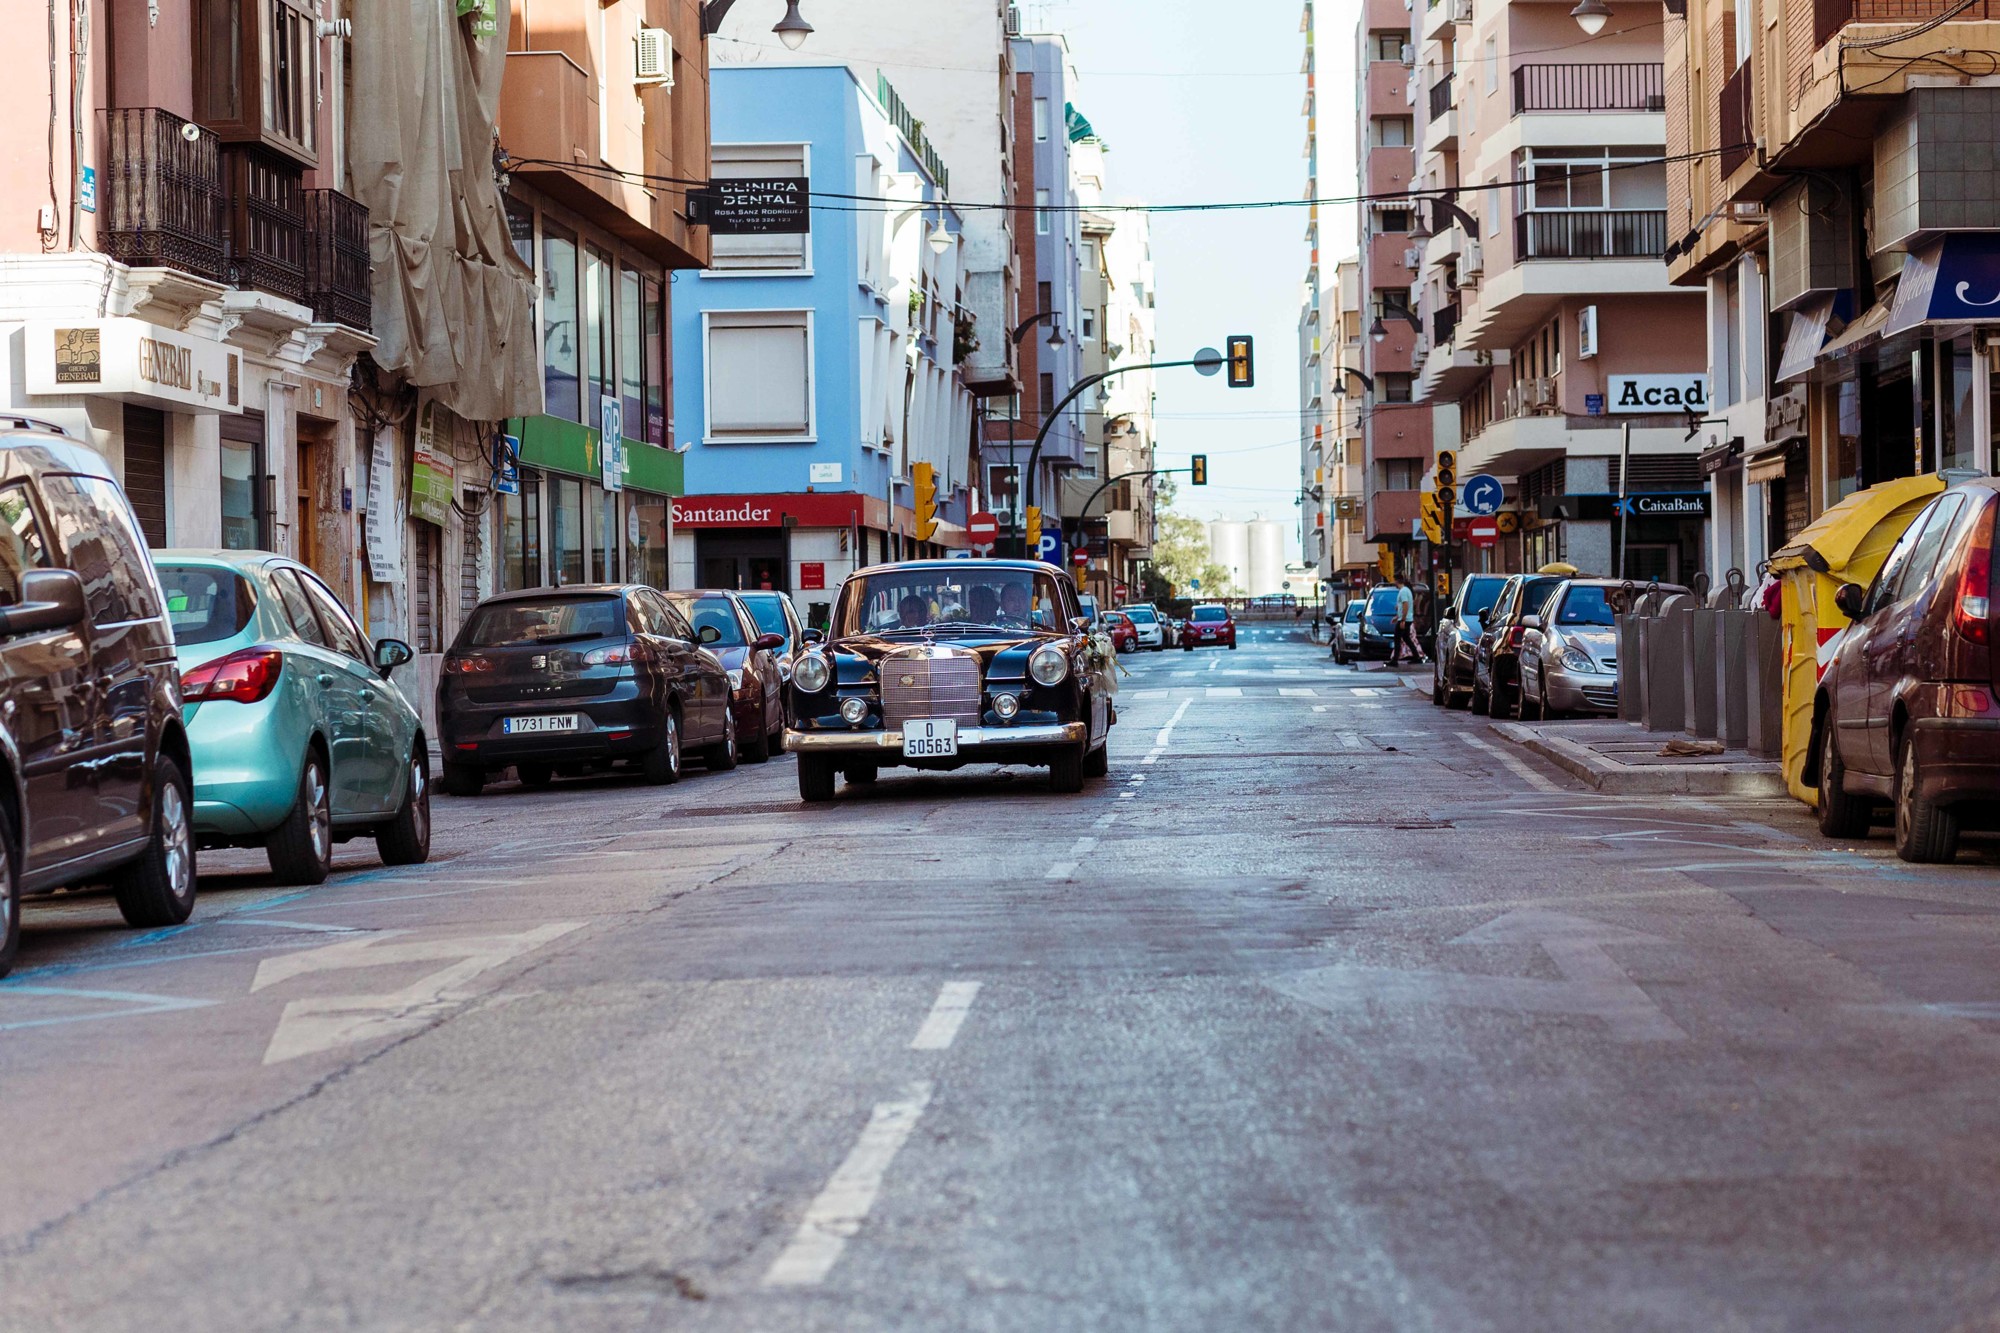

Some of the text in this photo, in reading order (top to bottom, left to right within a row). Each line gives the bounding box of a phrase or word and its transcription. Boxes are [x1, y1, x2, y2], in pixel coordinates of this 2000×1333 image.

[723, 194, 796, 205] DENTAL
[68, 365, 88, 373] GRUPO
[139, 336, 192, 391] GENERALI
[57, 372, 99, 381] GENERALI
[1618, 380, 1709, 406] Acad
[672, 502, 771, 523] Santander
[1639, 498, 1704, 512] CaixaBank
[1038, 535, 1056, 560] P
[516, 716, 572, 731] 1731 FNW
[909, 738, 951, 754] 50563
